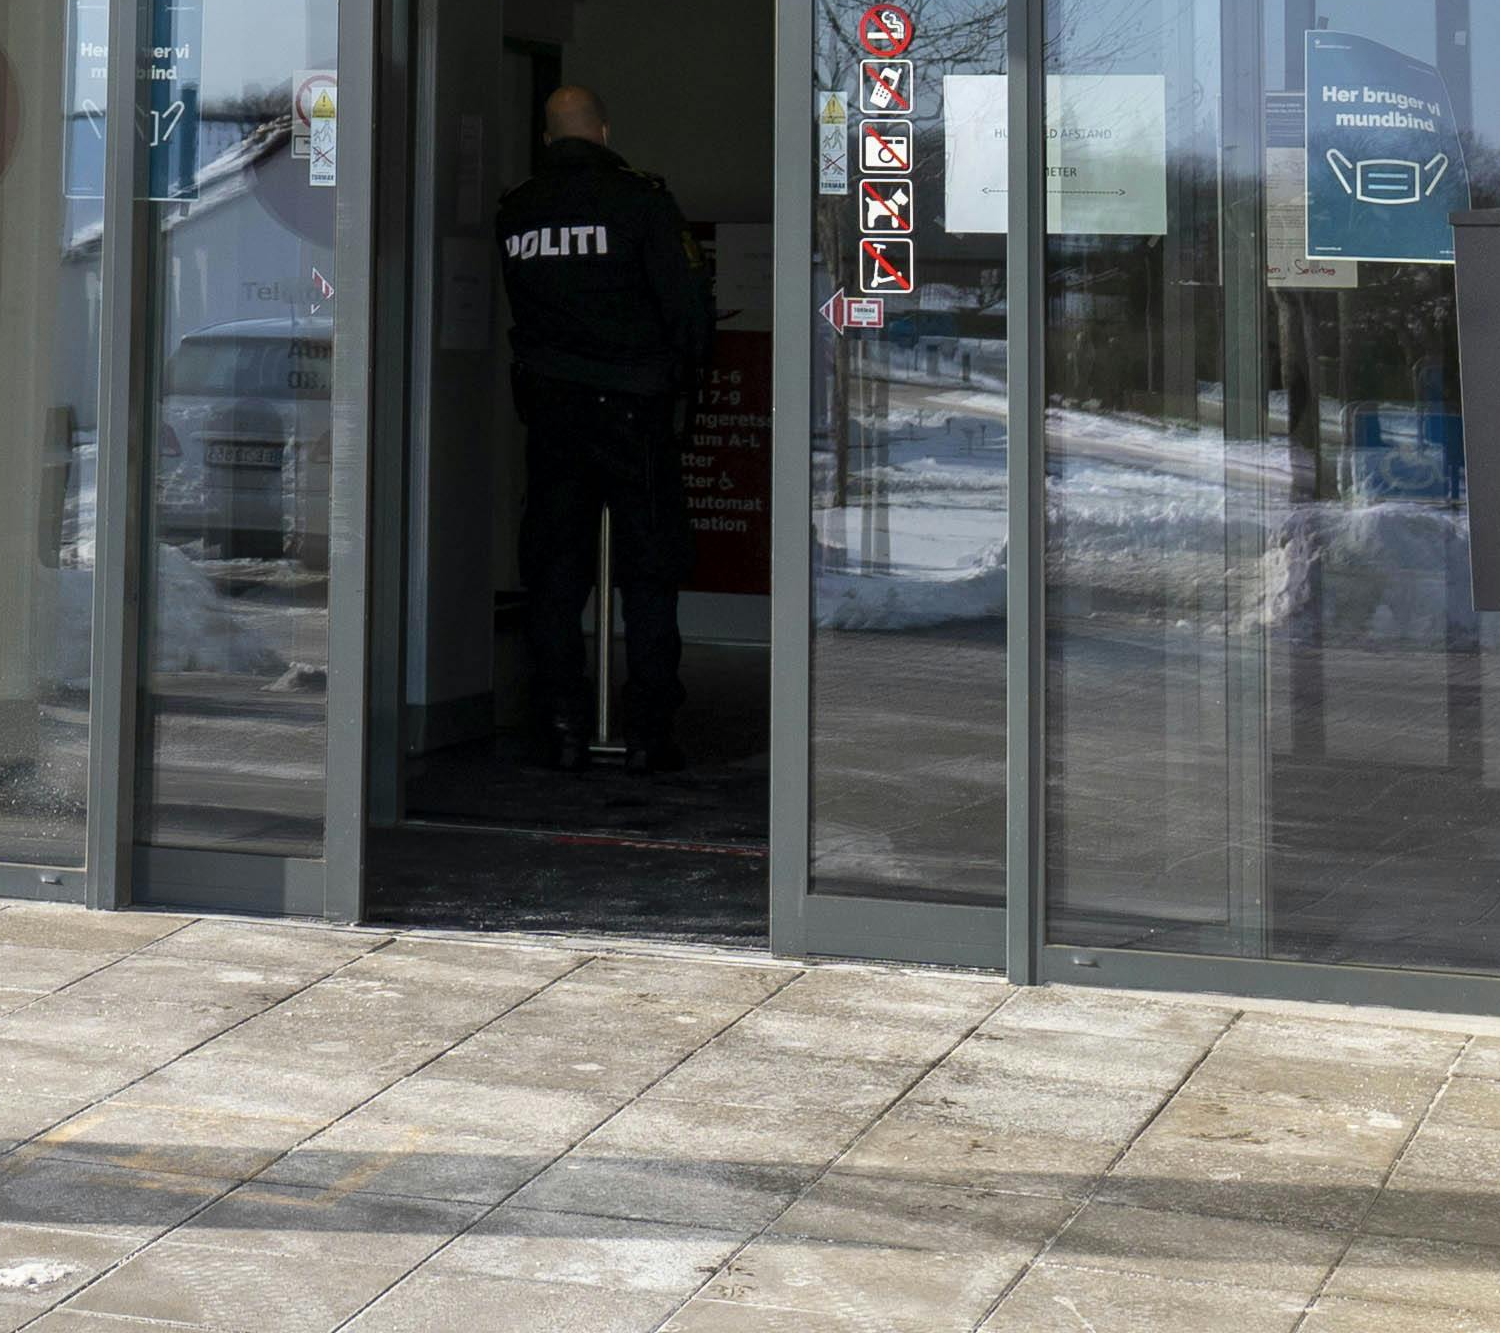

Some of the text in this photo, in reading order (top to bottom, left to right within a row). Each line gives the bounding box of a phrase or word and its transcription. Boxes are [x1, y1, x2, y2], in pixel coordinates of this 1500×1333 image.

[1322, 85, 1441, 117] Her bruger vi
[1335, 111, 1435, 133] mundbind
[1060, 128, 1112, 140] AFSTAND
